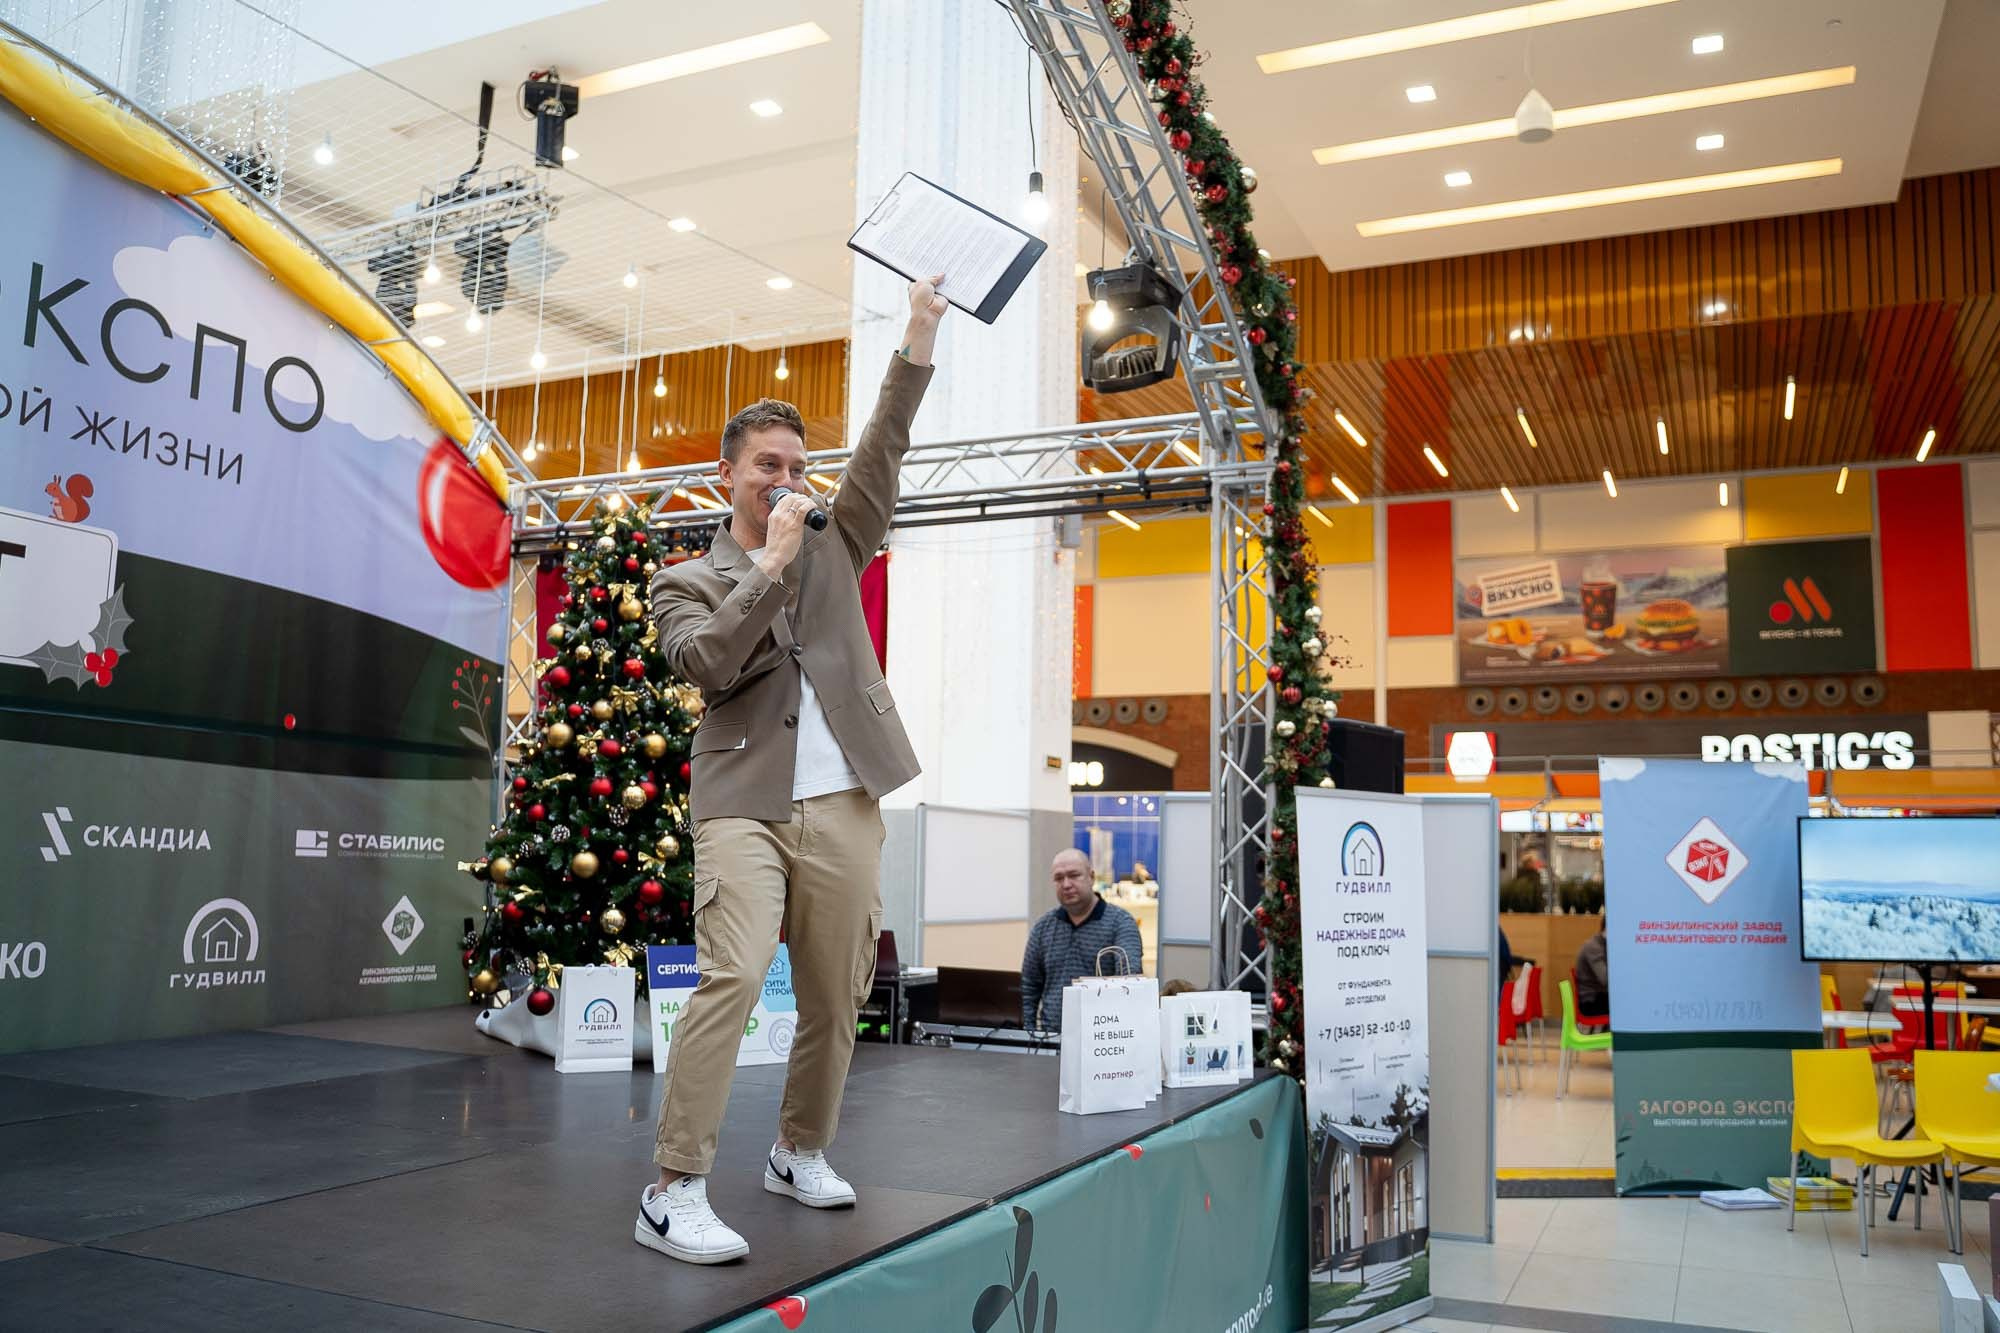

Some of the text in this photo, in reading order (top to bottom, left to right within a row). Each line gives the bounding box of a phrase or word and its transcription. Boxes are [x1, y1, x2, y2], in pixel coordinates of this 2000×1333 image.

[0, 261, 325, 433] КСПО
[83, 825, 211, 852] СКАНДИА
[339, 833, 445, 851] СТАБИЛИС
[1336, 882, 1391, 894] ГУДВИЛЛ
[1343, 912, 1384, 924] СТРОИМ
[1743, 921, 1782, 932] ЗАВОД
[1317, 928, 1406, 942] НАДЕЖНЫЕ ДОМА
[1337, 945, 1390, 958] ПОД КЛЮЧ
[169, 970, 266, 989] ГУДВИЛЛ
[1094, 1015, 1120, 1026] ДОМА
[1094, 1029, 1135, 1040] НЕ ВЫШЕ
[1318, 1028, 1331, 1040] +7
[1334, 1024, 1365, 1043] (3452)
[1094, 1046, 1125, 1056] СОСЕН
[1639, 1100, 1727, 1115] ЗАГОРОД
